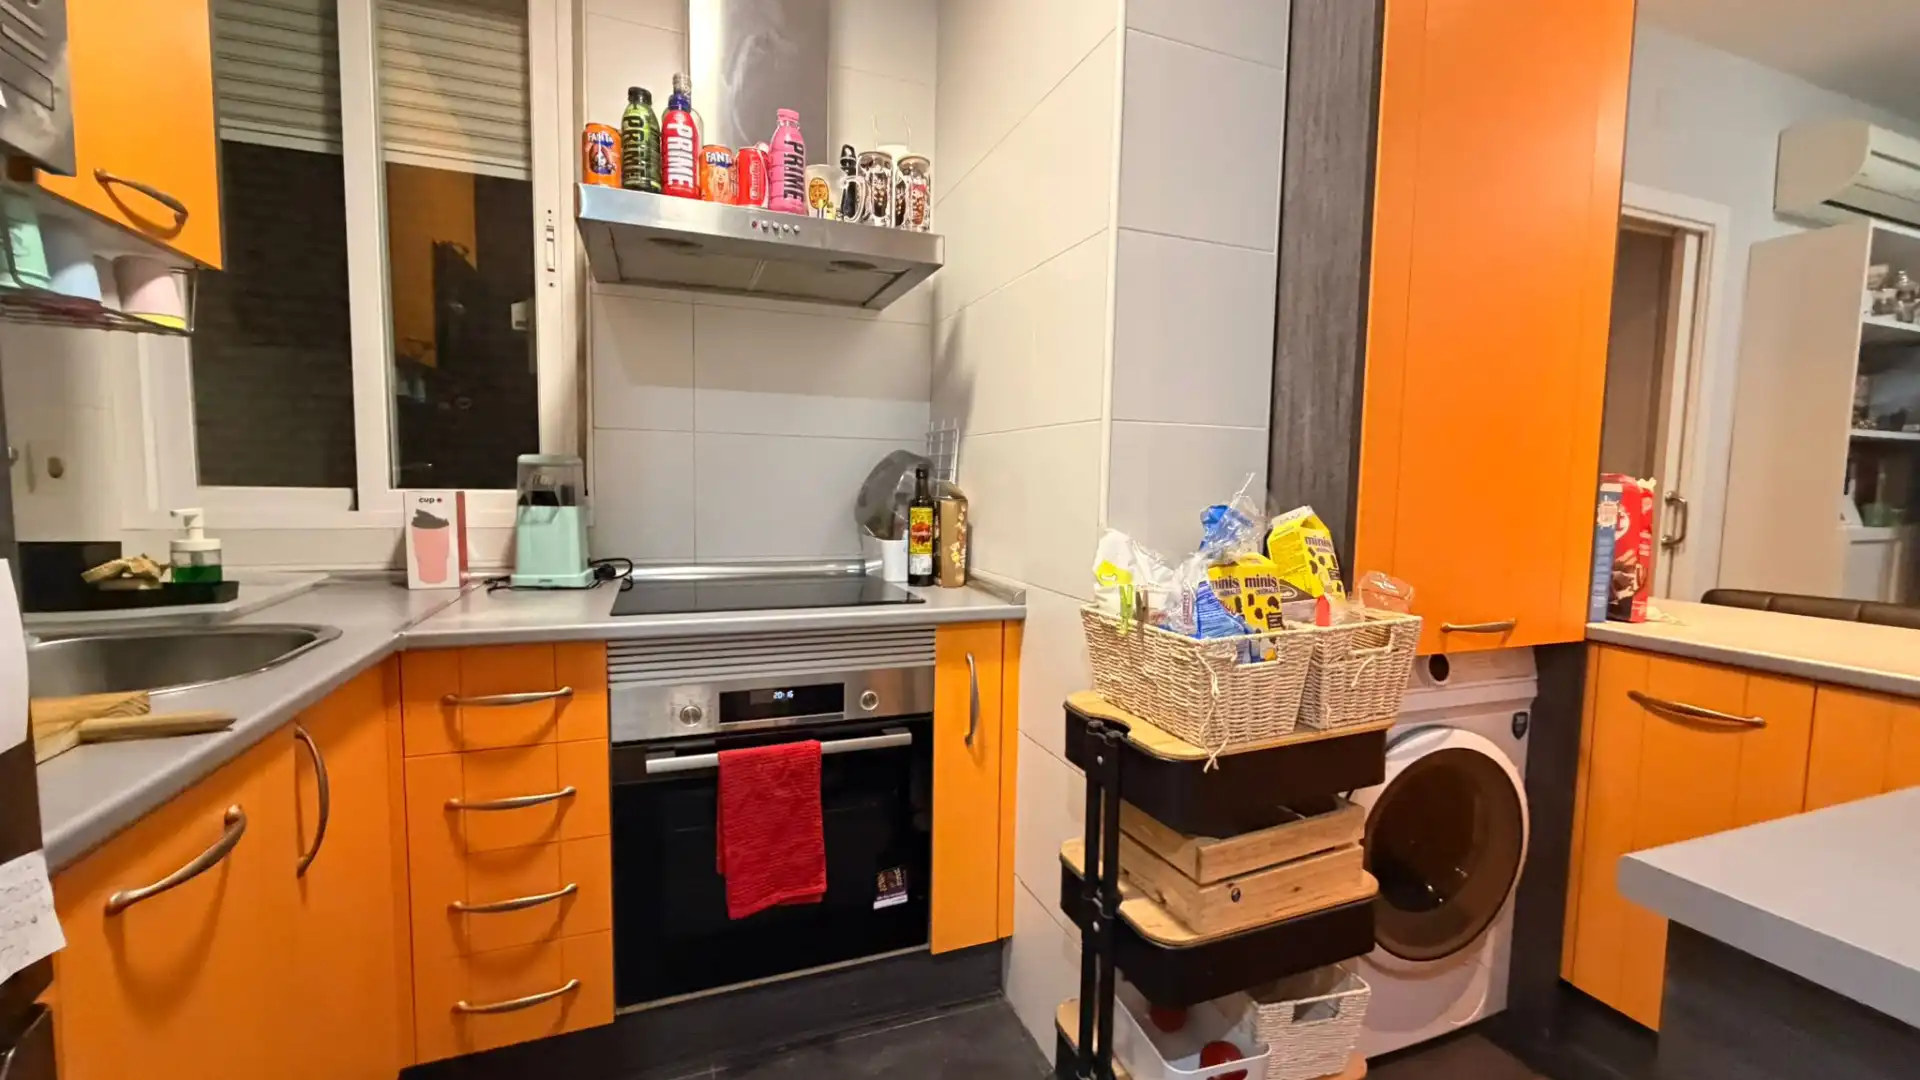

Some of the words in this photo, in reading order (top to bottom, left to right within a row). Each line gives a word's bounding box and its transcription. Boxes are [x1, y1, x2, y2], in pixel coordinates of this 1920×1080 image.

[667, 123, 694, 188] PRIME
[784, 140, 804, 202] PRIME
[1245, 573, 1278, 588] minis
